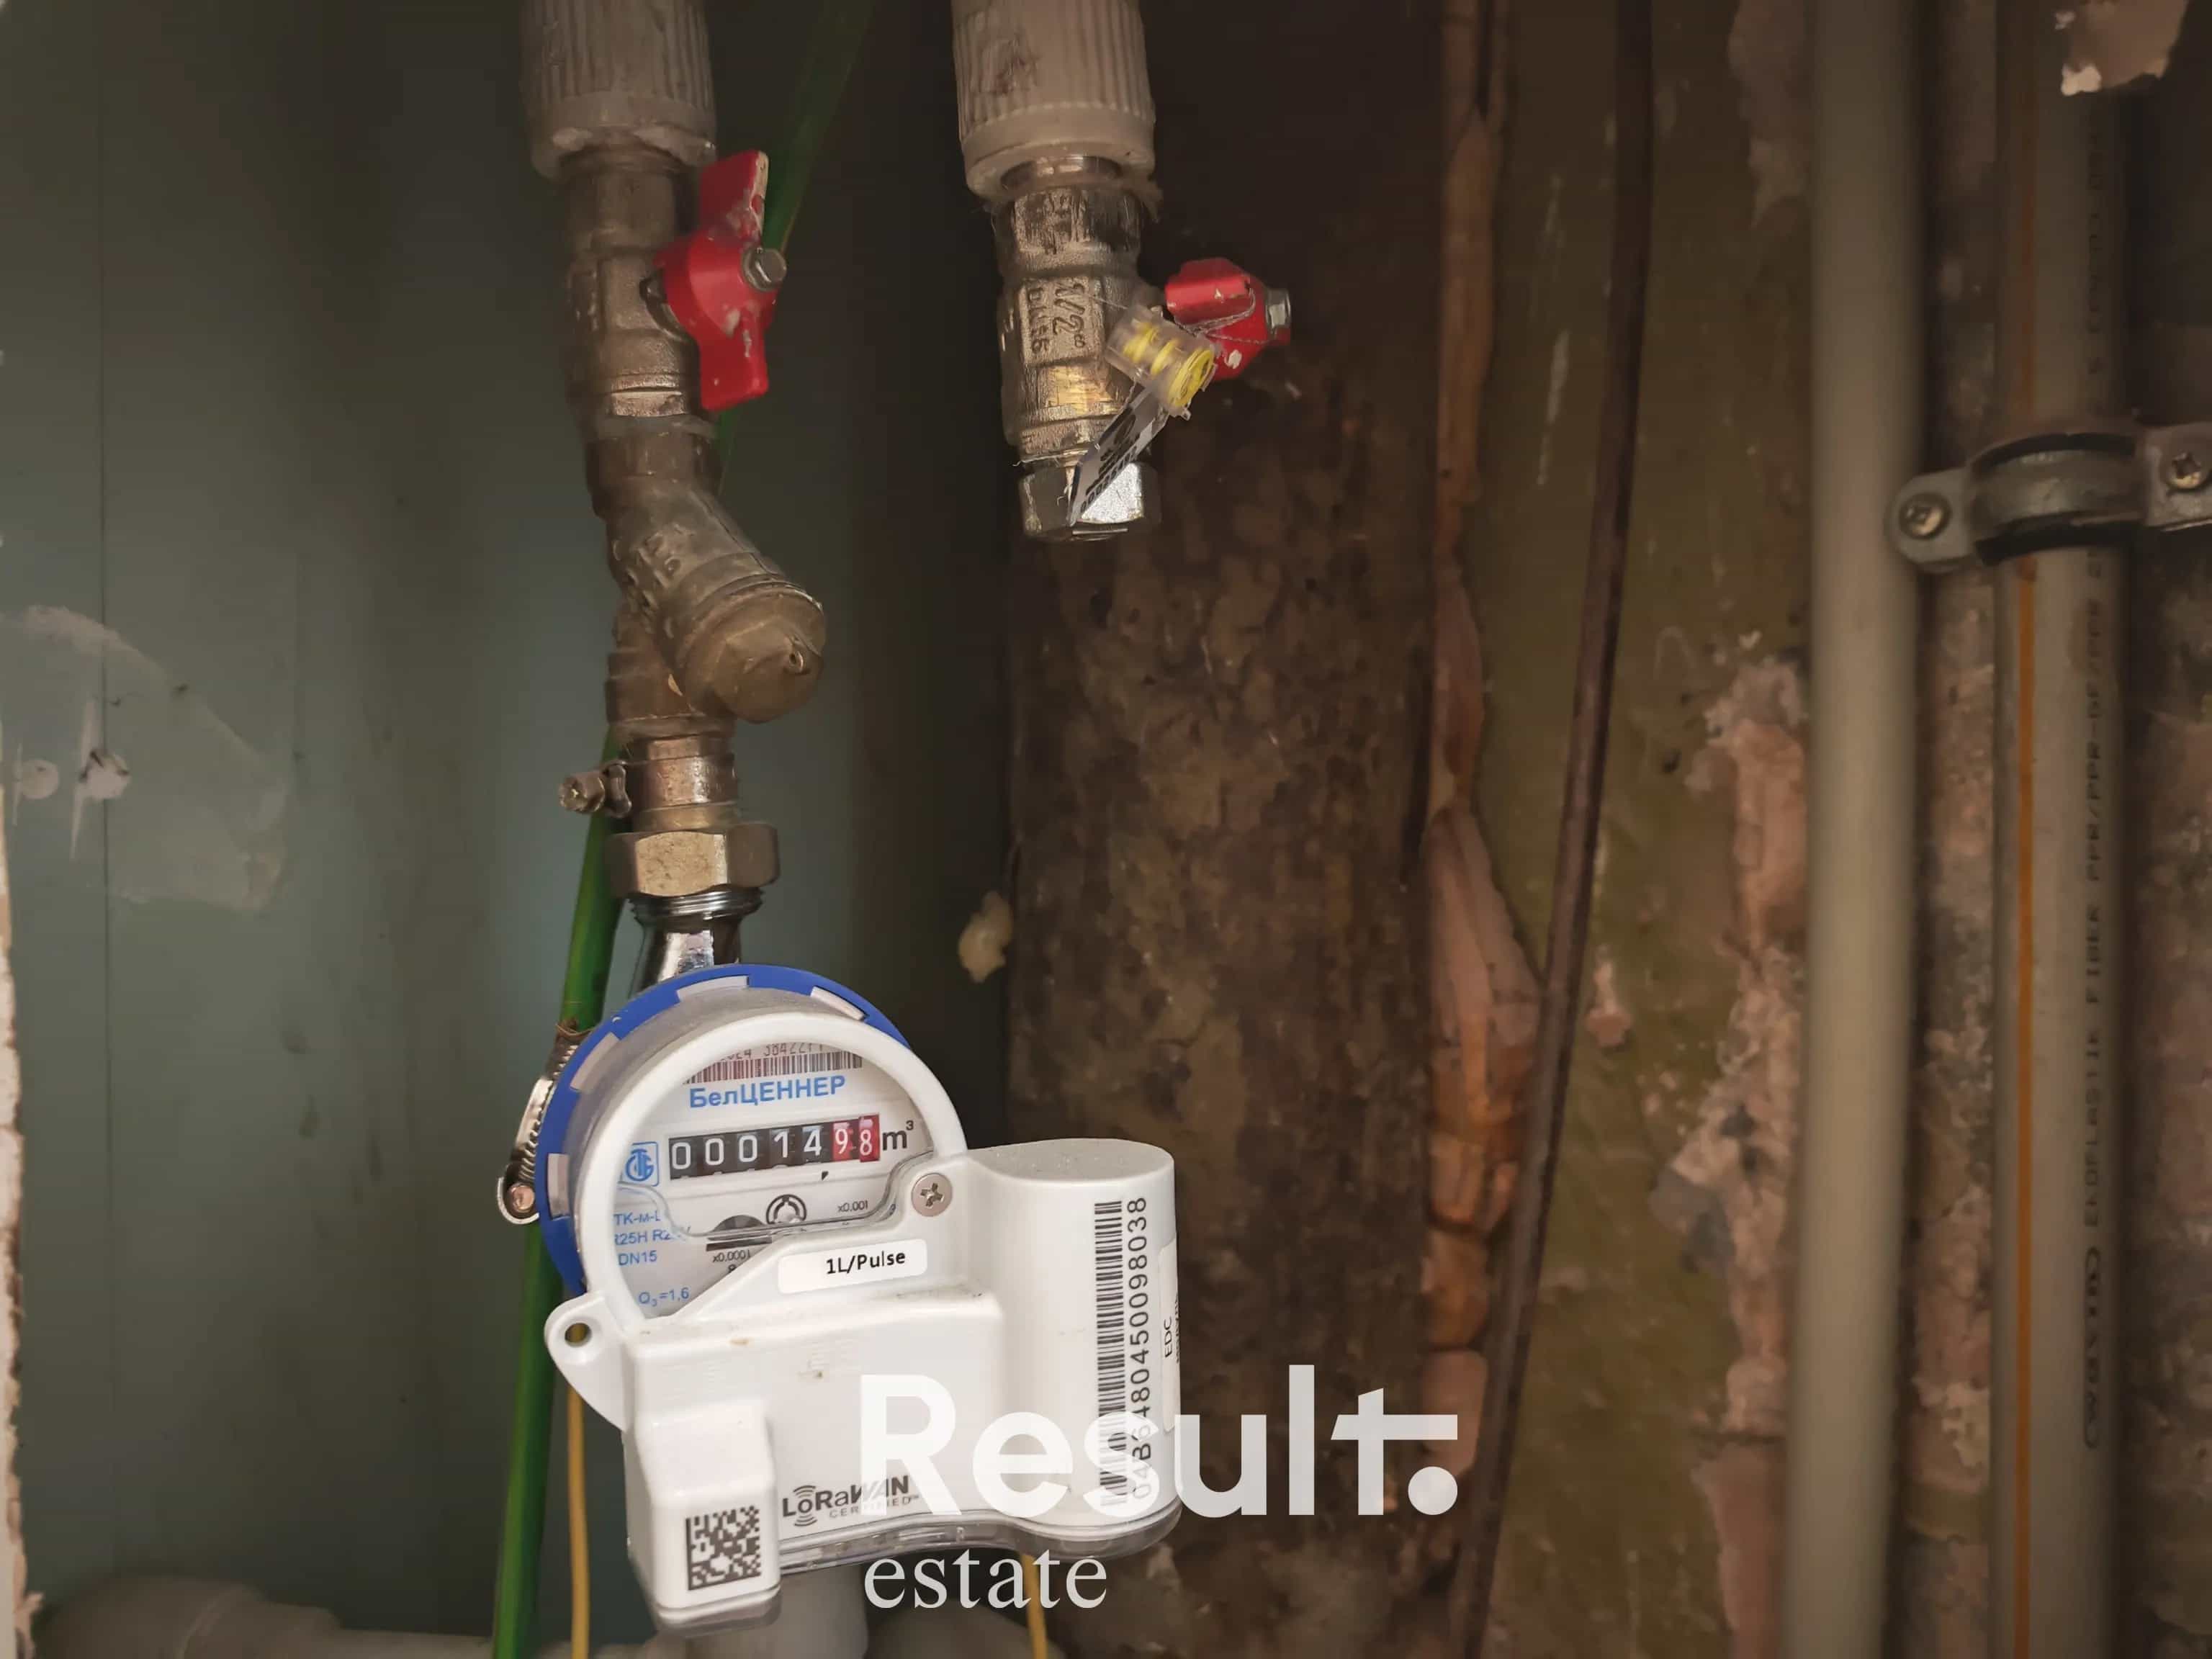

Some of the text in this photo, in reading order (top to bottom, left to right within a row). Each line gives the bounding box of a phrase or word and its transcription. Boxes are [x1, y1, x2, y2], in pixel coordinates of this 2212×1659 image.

[689, 1074, 846, 1109] БелЦЕННЕР
[671, 1128, 873, 1170] 0001498
[618, 1249, 657, 1266] DN15
[826, 1250, 906, 1274] 1L/Pulse
